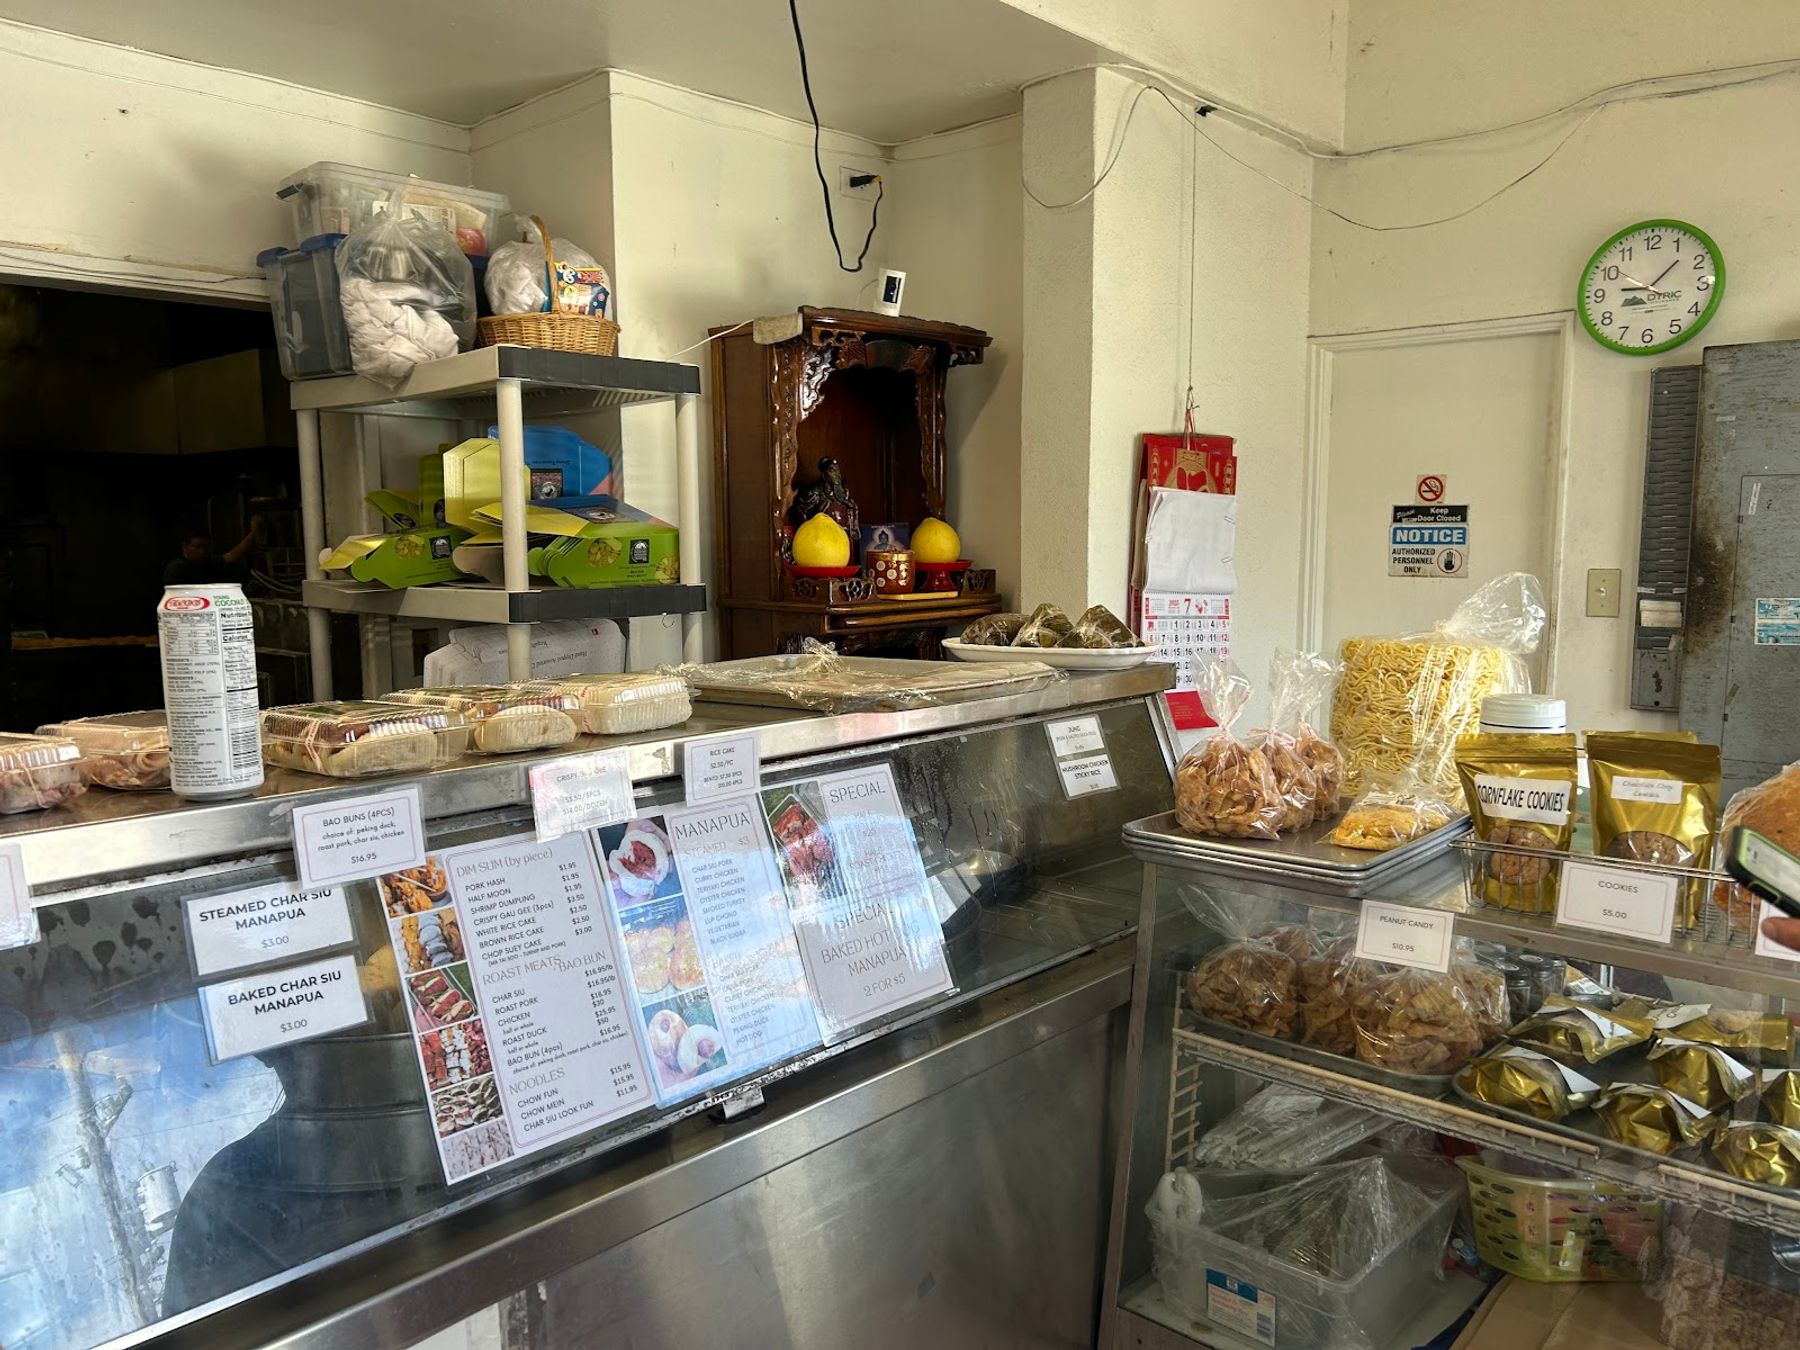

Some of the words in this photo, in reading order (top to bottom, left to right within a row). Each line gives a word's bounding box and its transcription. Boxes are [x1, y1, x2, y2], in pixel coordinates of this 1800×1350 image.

[1643, 234, 1662, 251] 12
[1673, 238, 1680, 252] 1
[1619, 246, 1633, 262] 11
[1693, 254, 1705, 270] 2
[1600, 265, 1620, 281] 10
[1696, 275, 1710, 292] 3
[1593, 288, 1605, 304] 9
[1687, 301, 1701, 316] 4
[1601, 311, 1613, 326] 8
[1669, 319, 1682, 334] 5
[1618, 326, 1630, 341] 7
[1641, 328, 1654, 344] 6
[1430, 507, 1449, 515] Keep
[1436, 514, 1461, 522] Closed
[1395, 529, 1464, 543] NOTICE
[1392, 548, 1436, 556] AUTHORIZED
[1392, 557, 1434, 565] PERSONNEL
[1184, 598, 1192, 614] 7
[1174, 621, 1179, 629] 1
[1185, 621, 1190, 629] 2
[1198, 621, 1202, 629] 3
[1210, 620, 1215, 628] 4
[1196, 634, 1204, 642] 10
[1209, 634, 1217, 642] 11
[829, 781, 886, 804] SPECIAL
[1477, 784, 1525, 808] CORNFLAKE
[1526, 790, 1564, 812] COOKIES
[322, 817, 341, 827] BAO
[343, 813, 366, 823] BUNS
[367, 807, 395, 821] (4PCS)
[322, 831, 344, 840] choice
[356, 825, 378, 835] peking
[379, 820, 396, 830] duck,
[675, 812, 750, 840] MANAPUA
[318, 843, 335, 851] roast
[336, 840, 353, 849] pork,
[353, 836, 368, 844] char
[381, 829, 405, 840] chicken
[351, 852, 377, 864] $16.95
[456, 862, 477, 878] DIM
[478, 858, 504, 874] SUM
[505, 855, 523, 869] (by
[523, 848, 553, 863] piece)
[465, 881, 485, 892] PORK
[486, 877, 506, 888] HASH
[558, 862, 577, 872] $1.95
[468, 893, 486, 903] HALF
[486, 888, 512, 900] MOON
[561, 873, 580, 883] $1.95
[1597, 880, 1639, 894] COOKIES
[199, 900, 267, 922] STEAMED
[270, 892, 308, 908] CHAR
[311, 888, 332, 900] SIU
[470, 903, 498, 915] SHRIMP
[498, 894, 536, 909] DUMPLING
[564, 883, 583, 894] $1.95
[235, 907, 306, 931] MANAPUA
[473, 915, 499, 927] CRISPY
[500, 910, 517, 920] GAU
[518, 906, 532, 916] GEE
[475, 927, 499, 938] WHITE
[501, 921, 517, 932] RICE
[518, 916, 537, 928] CAKE
[569, 904, 588, 915] $2.50
[1379, 915, 1407, 926] PEANUT
[1407, 920, 1434, 930] CANDY
[1602, 909, 1627, 919] $5.00
[479, 936, 507, 949] BROWN
[508, 932, 525, 942] RICE
[525, 926, 545, 938] CAKE
[572, 915, 590, 926] $2.50
[261, 935, 290, 949] $3.00
[481, 949, 503, 961] CHOP
[504, 944, 522, 955] SUEY
[523, 938, 543, 949] CAKE
[574, 926, 593, 936] $3.00
[820, 939, 864, 964] BAKED
[865, 930, 892, 949] HOT
[1392, 942, 1414, 952] $10.95
[482, 965, 521, 986] ROAST
[559, 957, 582, 973] BAO
[583, 950, 607, 963] BUN
[847, 946, 907, 977] MANAPUA
[227, 985, 277, 1006] BAKED
[280, 976, 318, 993] CHAR
[321, 970, 342, 984] SIU
[863, 985, 873, 997] 2
[872, 979, 893, 994] FOR
[893, 972, 906, 985] $5
[253, 990, 324, 1016] MANAPUA
[492, 992, 513, 1005] CHAR
[514, 989, 526, 999] SIU
[591, 998, 605, 1009] $30
[495, 1003, 519, 1016] ROAST
[519, 996, 539, 1009] PORK
[280, 1018, 308, 1033] $3.00
[498, 1012, 531, 1027] CHICKEN
[502, 1033, 526, 1047] ROAST
[527, 1026, 548, 1040] DUCK
[507, 1056, 524, 1067] BAO
[525, 1050, 540, 1061] BUN
[541, 1041, 563, 1057] (4pcs)
[599, 1023, 621, 1037] $16.95
[509, 1067, 566, 1096] NOODLES
[517, 1092, 542, 1109] CHOW
[543, 1088, 559, 1100] FUN
[609, 1062, 632, 1076] $15.95
[521, 1106, 546, 1120] CHOW
[546, 1099, 566, 1112] MEIN
[613, 1073, 635, 1087] $15.95
[523, 1119, 545, 1133] CHAR
[546, 1114, 558, 1124] SIU
[559, 1107, 580, 1121] LOOK
[580, 1100, 595, 1112] FUN
[616, 1084, 639, 1098] $11.95
